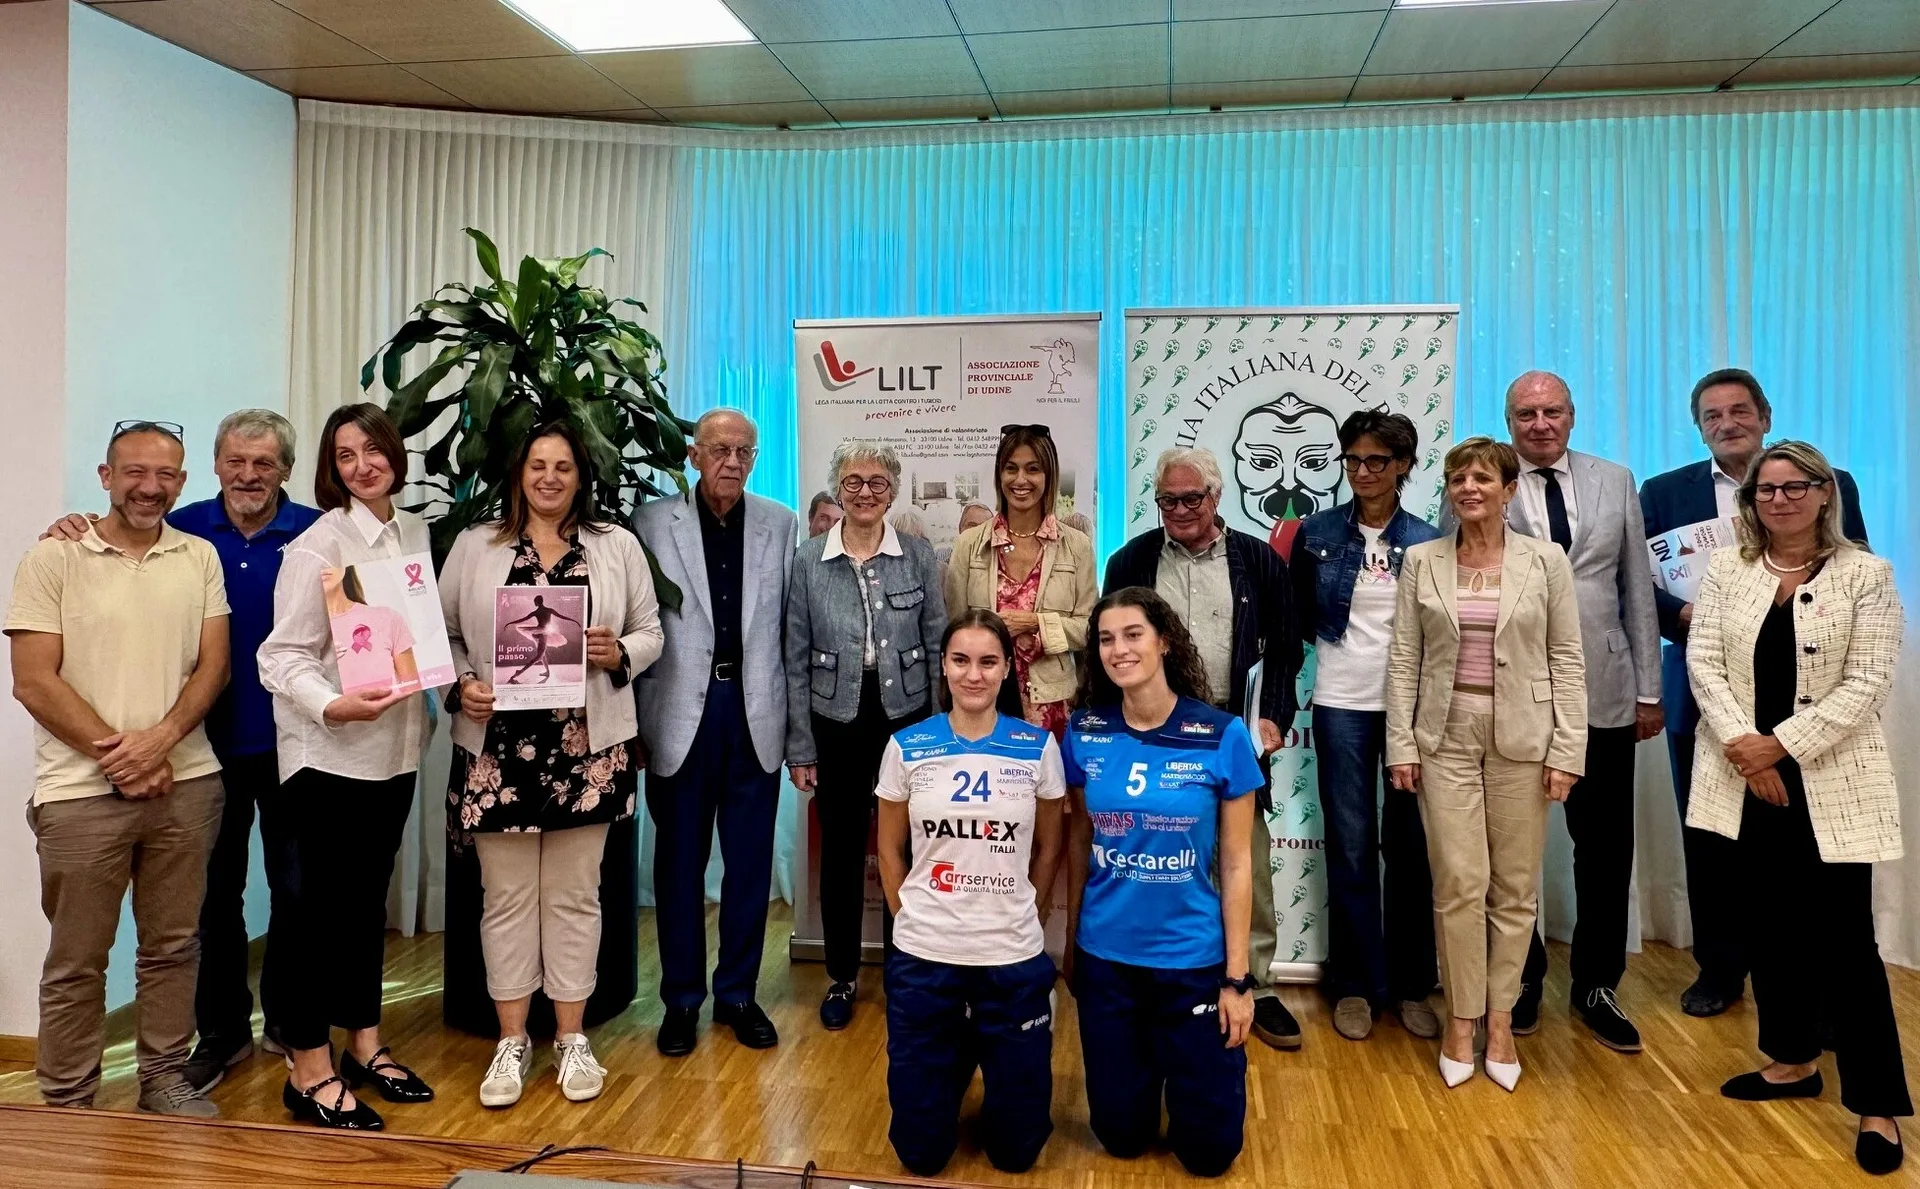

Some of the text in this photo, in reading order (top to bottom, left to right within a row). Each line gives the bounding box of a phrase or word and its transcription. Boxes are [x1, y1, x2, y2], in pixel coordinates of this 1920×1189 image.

[967, 361, 1040, 369] ASSOCIAZIONE
[878, 365, 943, 391] LILT
[967, 373, 1034, 382] PROVINCIALE
[1193, 351, 1316, 413] ITALIANA
[1322, 358, 1368, 403] DEL
[967, 386, 1012, 395] DI UDINE
[865, 408, 913, 421] prevenire
[924, 404, 957, 414] vivere
[506, 644, 533, 654] primo
[498, 654, 528, 662] passo.
[1165, 761, 1203, 771] LIBERTAS
[999, 768, 1034, 778] LIBERTAS
[1125, 762, 1148, 797] 5
[950, 769, 992, 803] 24
[922, 819, 1020, 842] PALLEX
[989, 844, 1016, 854] ITALIA
[1105, 848, 1197, 870] Ceccarelli
